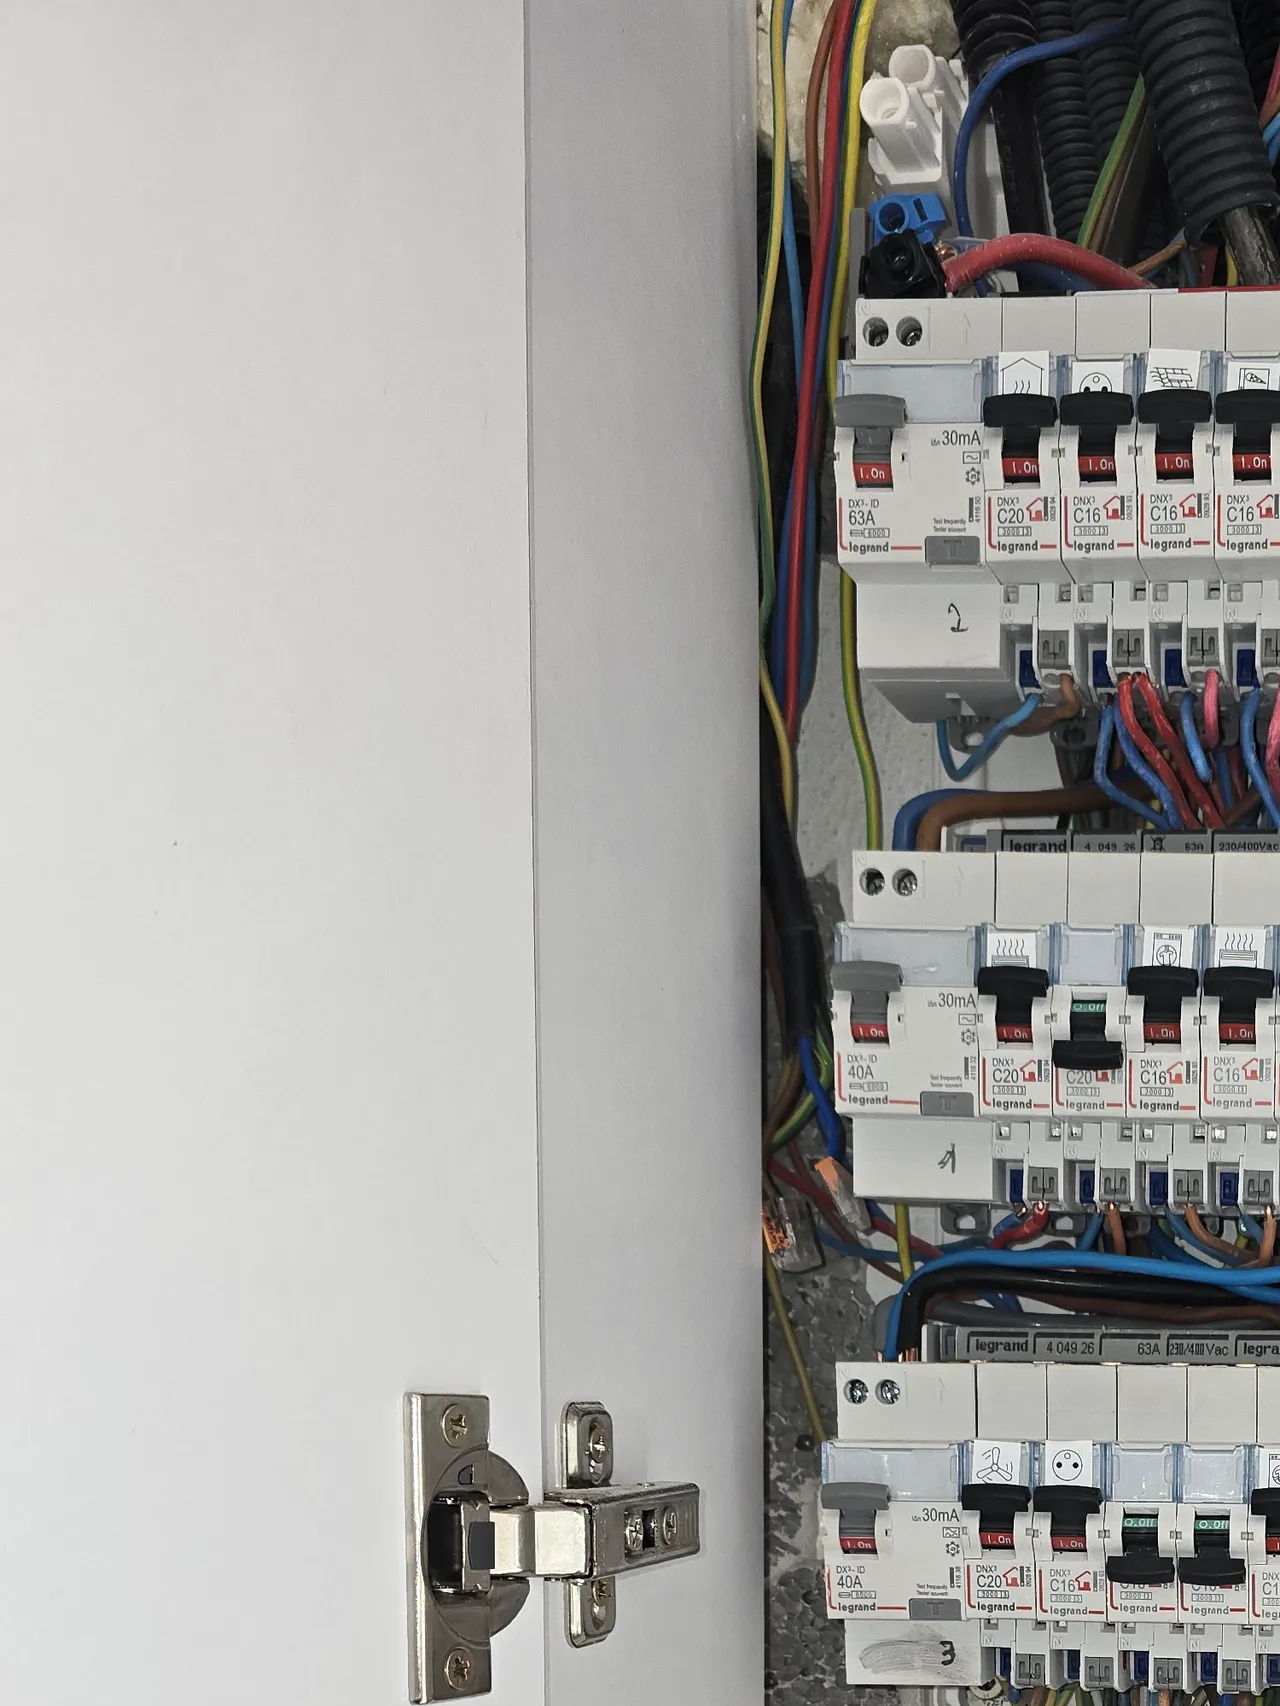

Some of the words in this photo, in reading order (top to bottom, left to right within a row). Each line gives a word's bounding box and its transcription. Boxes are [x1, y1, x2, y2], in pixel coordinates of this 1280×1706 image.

[942, 431, 981, 446] 30mA
[848, 511, 875, 525] 63A
[998, 510, 1024, 524] C20
[1074, 507, 1100, 523] C16
[1150, 505, 1178, 521] C16
[1227, 505, 1254, 522] C16
[848, 542, 889, 554] legrand
[997, 542, 1038, 552] legrand
[1074, 540, 1115, 552] legrand
[1150, 537, 1191, 551] legrand
[1226, 538, 1268, 551] legrand
[938, 993, 976, 1009] 30mA
[848, 1065, 874, 1080] 40A
[992, 1068, 1019, 1083] C20
[1066, 1070, 1091, 1084] C20
[1140, 1069, 1166, 1084] C16
[1213, 1068, 1240, 1082] C16
[848, 1094, 888, 1107] legrand
[991, 1100, 1032, 1111] legrand
[1065, 1100, 1105, 1111] legrand
[1139, 1100, 1179, 1112] legrand
[1212, 1099, 1252, 1110] legrand
[975, 1339, 1028, 1353] legrand
[1137, 1343, 1160, 1355] 63A
[922, 1508, 959, 1523] 30mA
[837, 1575, 863, 1589] 40A
[976, 1574, 1001, 1588] C20
[1050, 1579, 1075, 1593] C16
[838, 1602, 876, 1613] legrand
[977, 1602, 1015, 1613] legrand
[1050, 1606, 1088, 1616] legrand
[1119, 1604, 1158, 1615] legrand
[1190, 1605, 1230, 1617] legrand
[940, 1640, 956, 1666] 3
